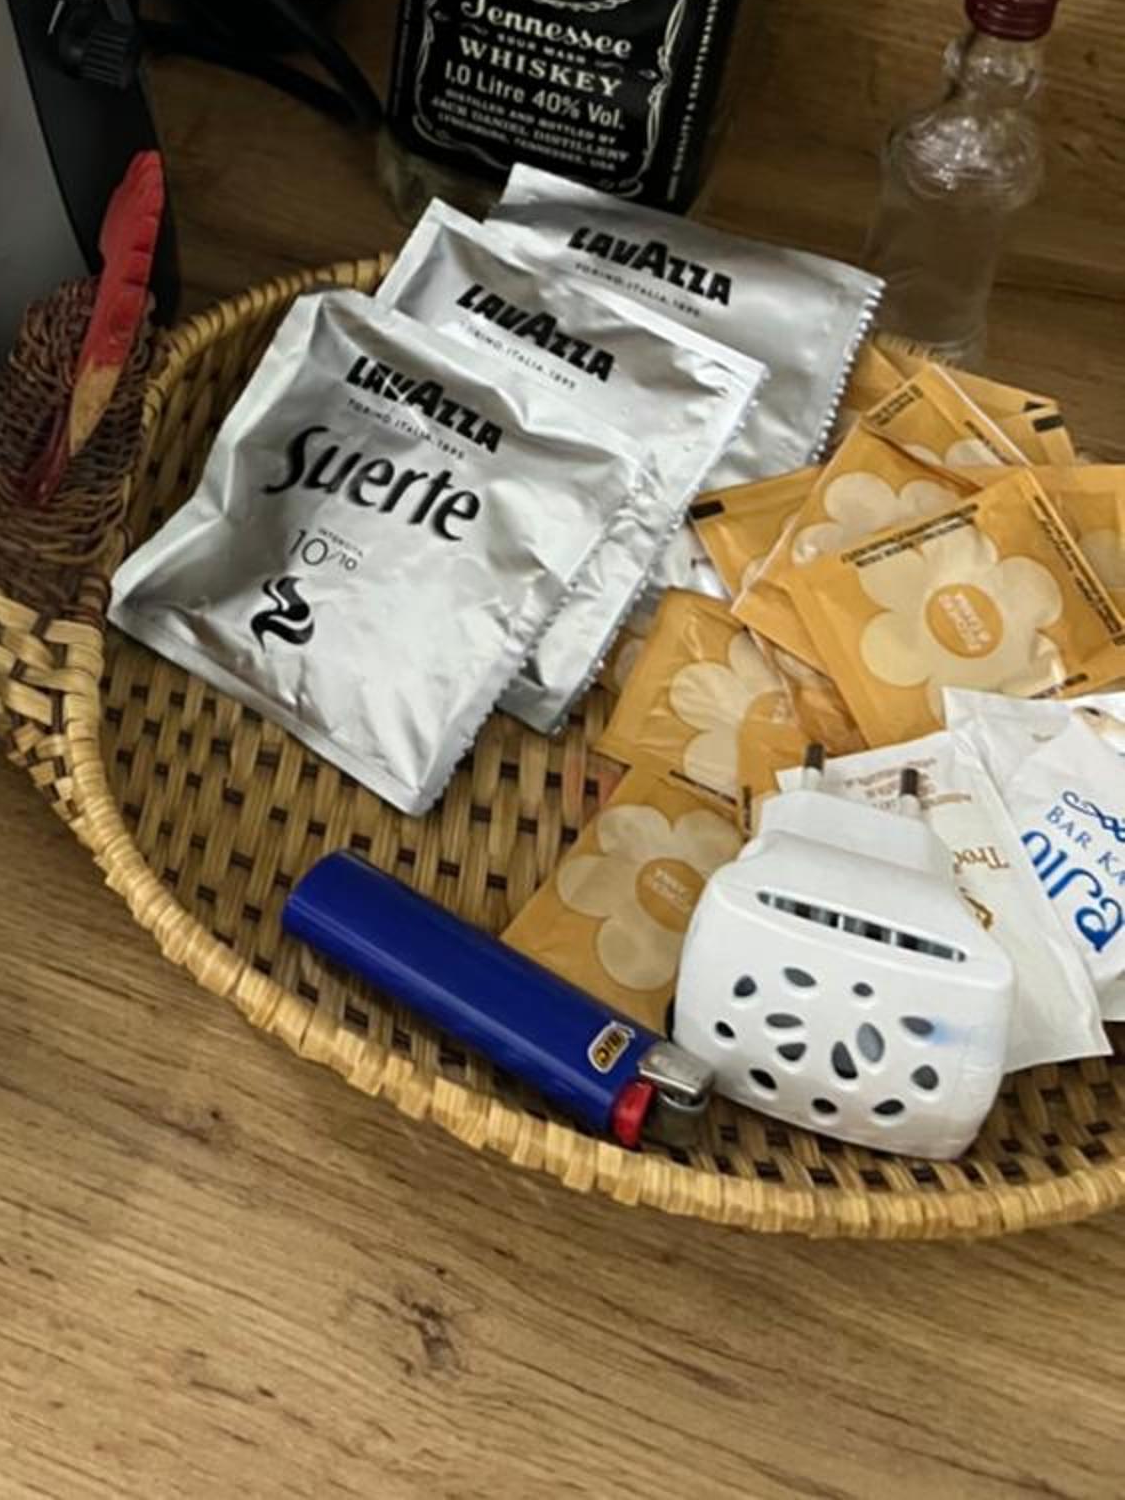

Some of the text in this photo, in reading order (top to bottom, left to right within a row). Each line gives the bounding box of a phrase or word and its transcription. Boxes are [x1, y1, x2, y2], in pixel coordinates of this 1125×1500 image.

[459, 35, 623, 97] WHISKEY
[476, 70, 525, 103] Litre
[532, 89, 581, 121] 40%
[587, 100, 626, 132] Vol.
[568, 227, 732, 306] LAVAZZA
[456, 283, 615, 383] LAVAZZA
[346, 355, 503, 453] LAVAZZA
[265, 425, 481, 542] Suerte
[1045, 805, 1093, 850] BAR
